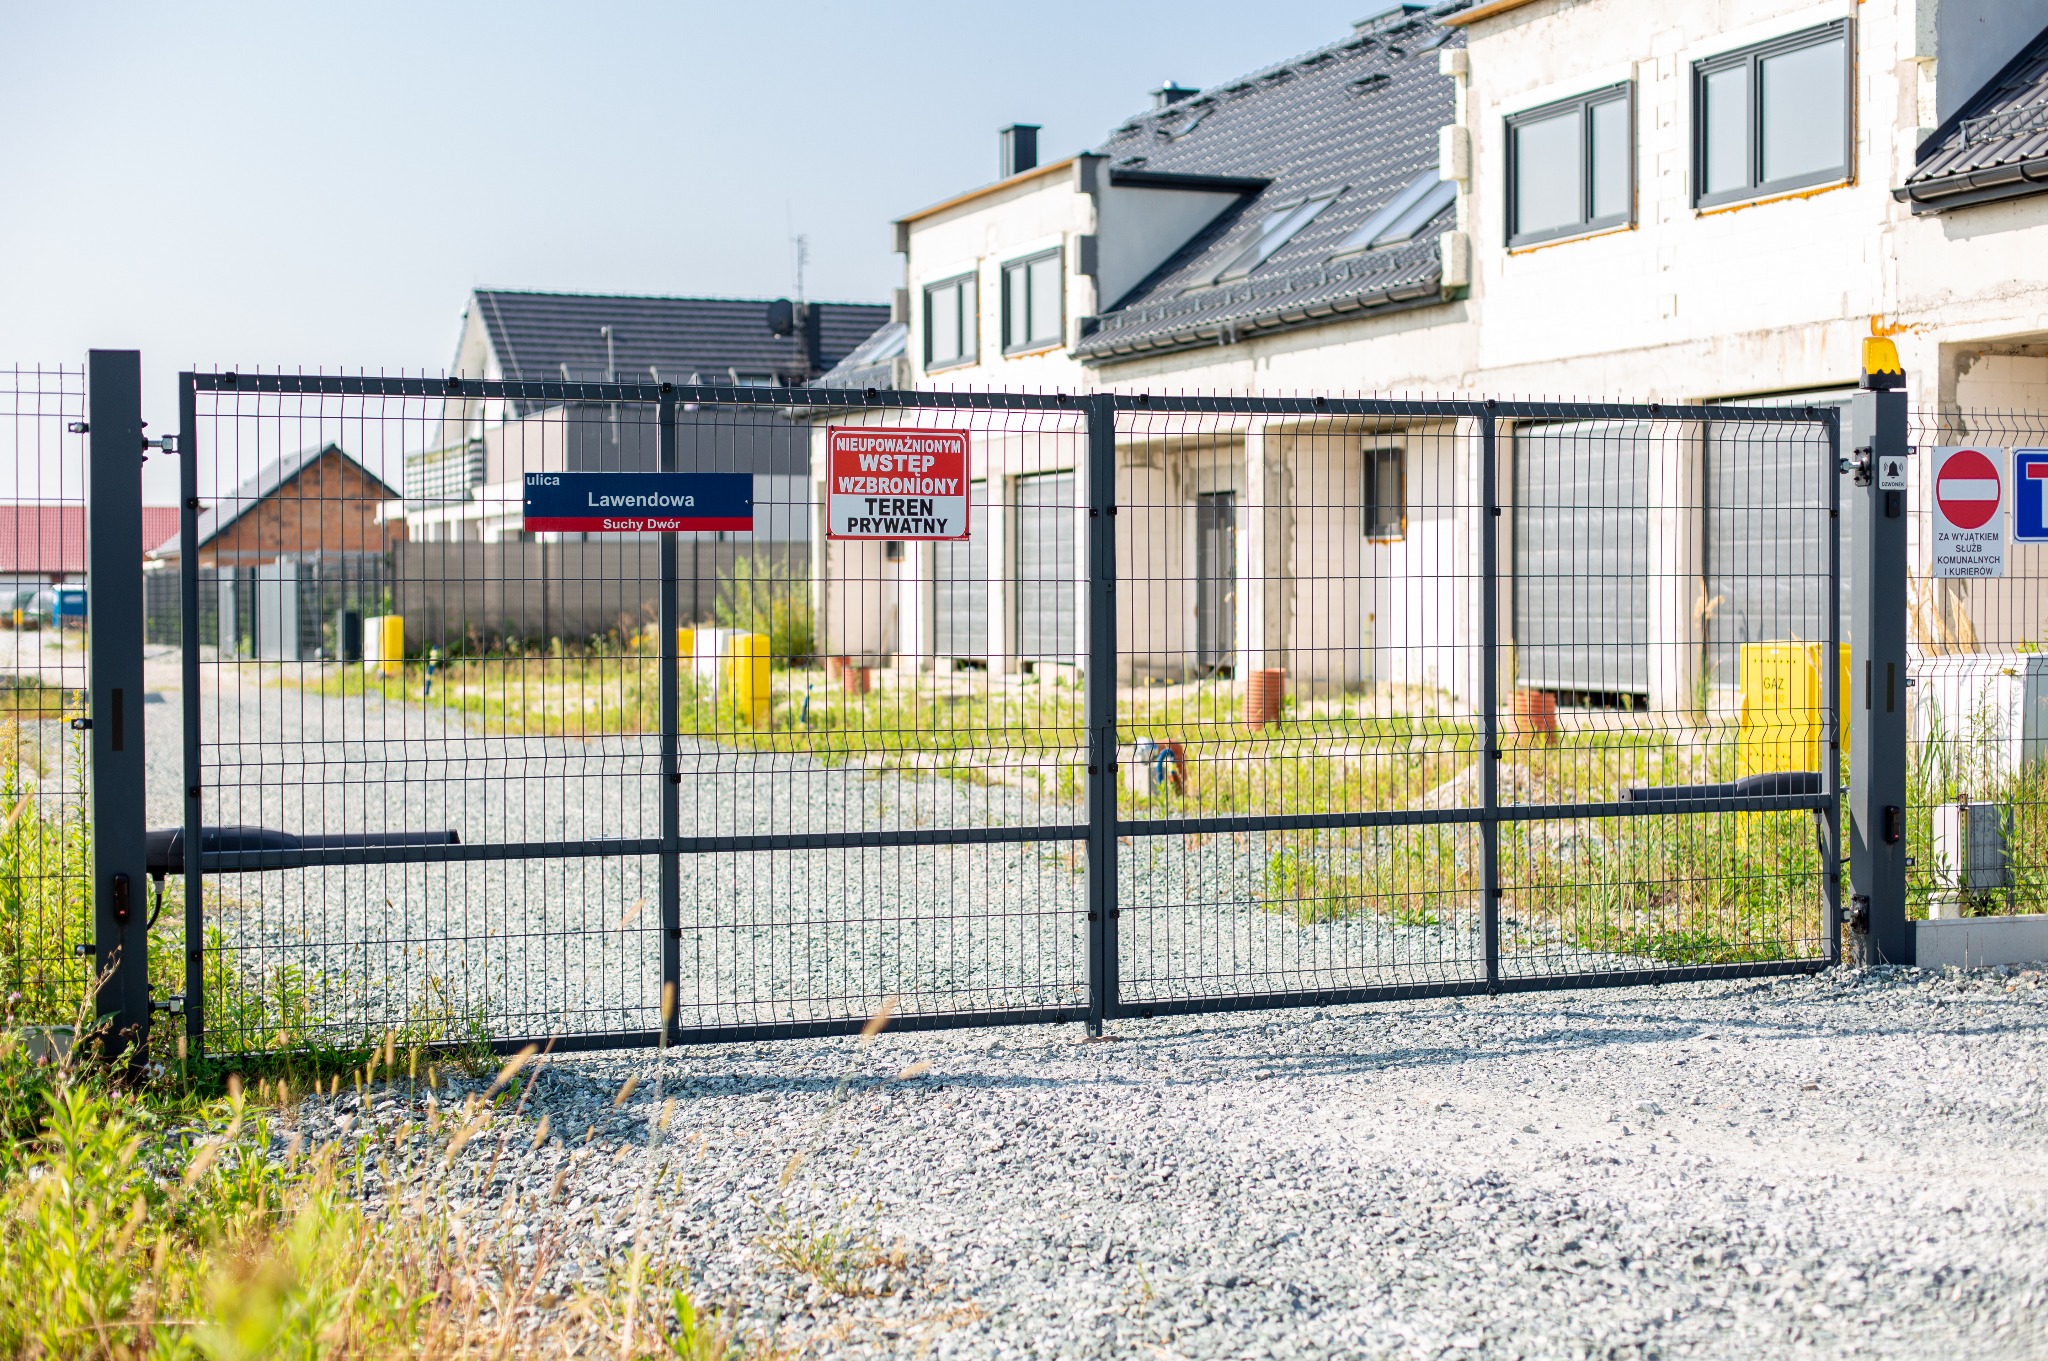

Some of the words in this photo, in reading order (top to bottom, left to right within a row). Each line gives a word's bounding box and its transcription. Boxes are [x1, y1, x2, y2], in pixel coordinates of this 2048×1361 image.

[836, 435, 961, 453] NIEUPOWAŻNIONYM
[859, 453, 935, 477] WSTĘP
[526, 473, 560, 486] ulica
[838, 476, 959, 495] WZBRONIONY
[588, 491, 695, 507] Lawendowa
[864, 498, 934, 516] TEREN
[603, 518, 644, 531] Suchy
[647, 518, 681, 529] Dwór
[847, 517, 949, 534] PRYWATNY
[1938, 532, 1950, 541] ZA
[1951, 532, 1999, 542] WYJĄTKIEM
[1955, 543, 1983, 553] SŁUŻB
[1937, 556, 2001, 564] KOMUNALNYCH
[1944, 567, 1947, 576] I
[1949, 566, 1993, 576] KURIERÓW
[1763, 677, 1785, 690] GAZ
